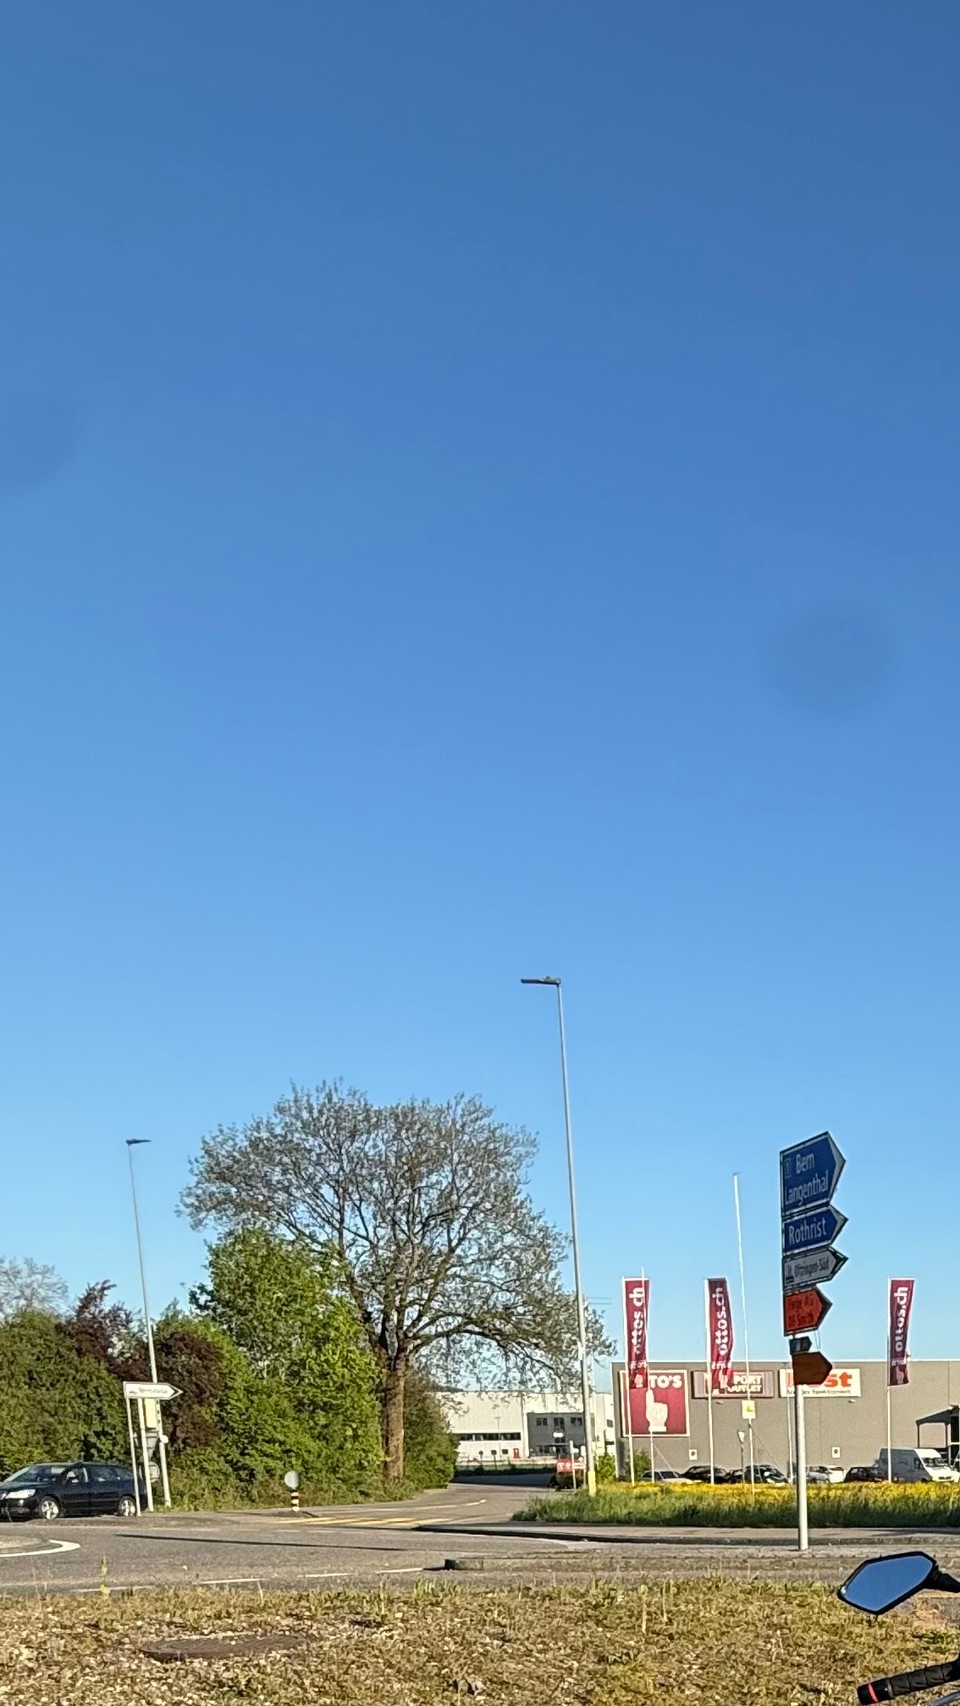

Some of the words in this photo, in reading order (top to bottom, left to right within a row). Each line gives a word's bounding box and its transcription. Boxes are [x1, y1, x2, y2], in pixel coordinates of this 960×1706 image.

[796, 1153, 815, 1174] Bern
[785, 1169, 829, 1206] Langenthal
[788, 1217, 827, 1246] Rothrist
[712, 1287, 728, 1355] ottos.ch
[893, 1287, 908, 1352] ottos.ch
[732, 1374, 761, 1385] PORT
